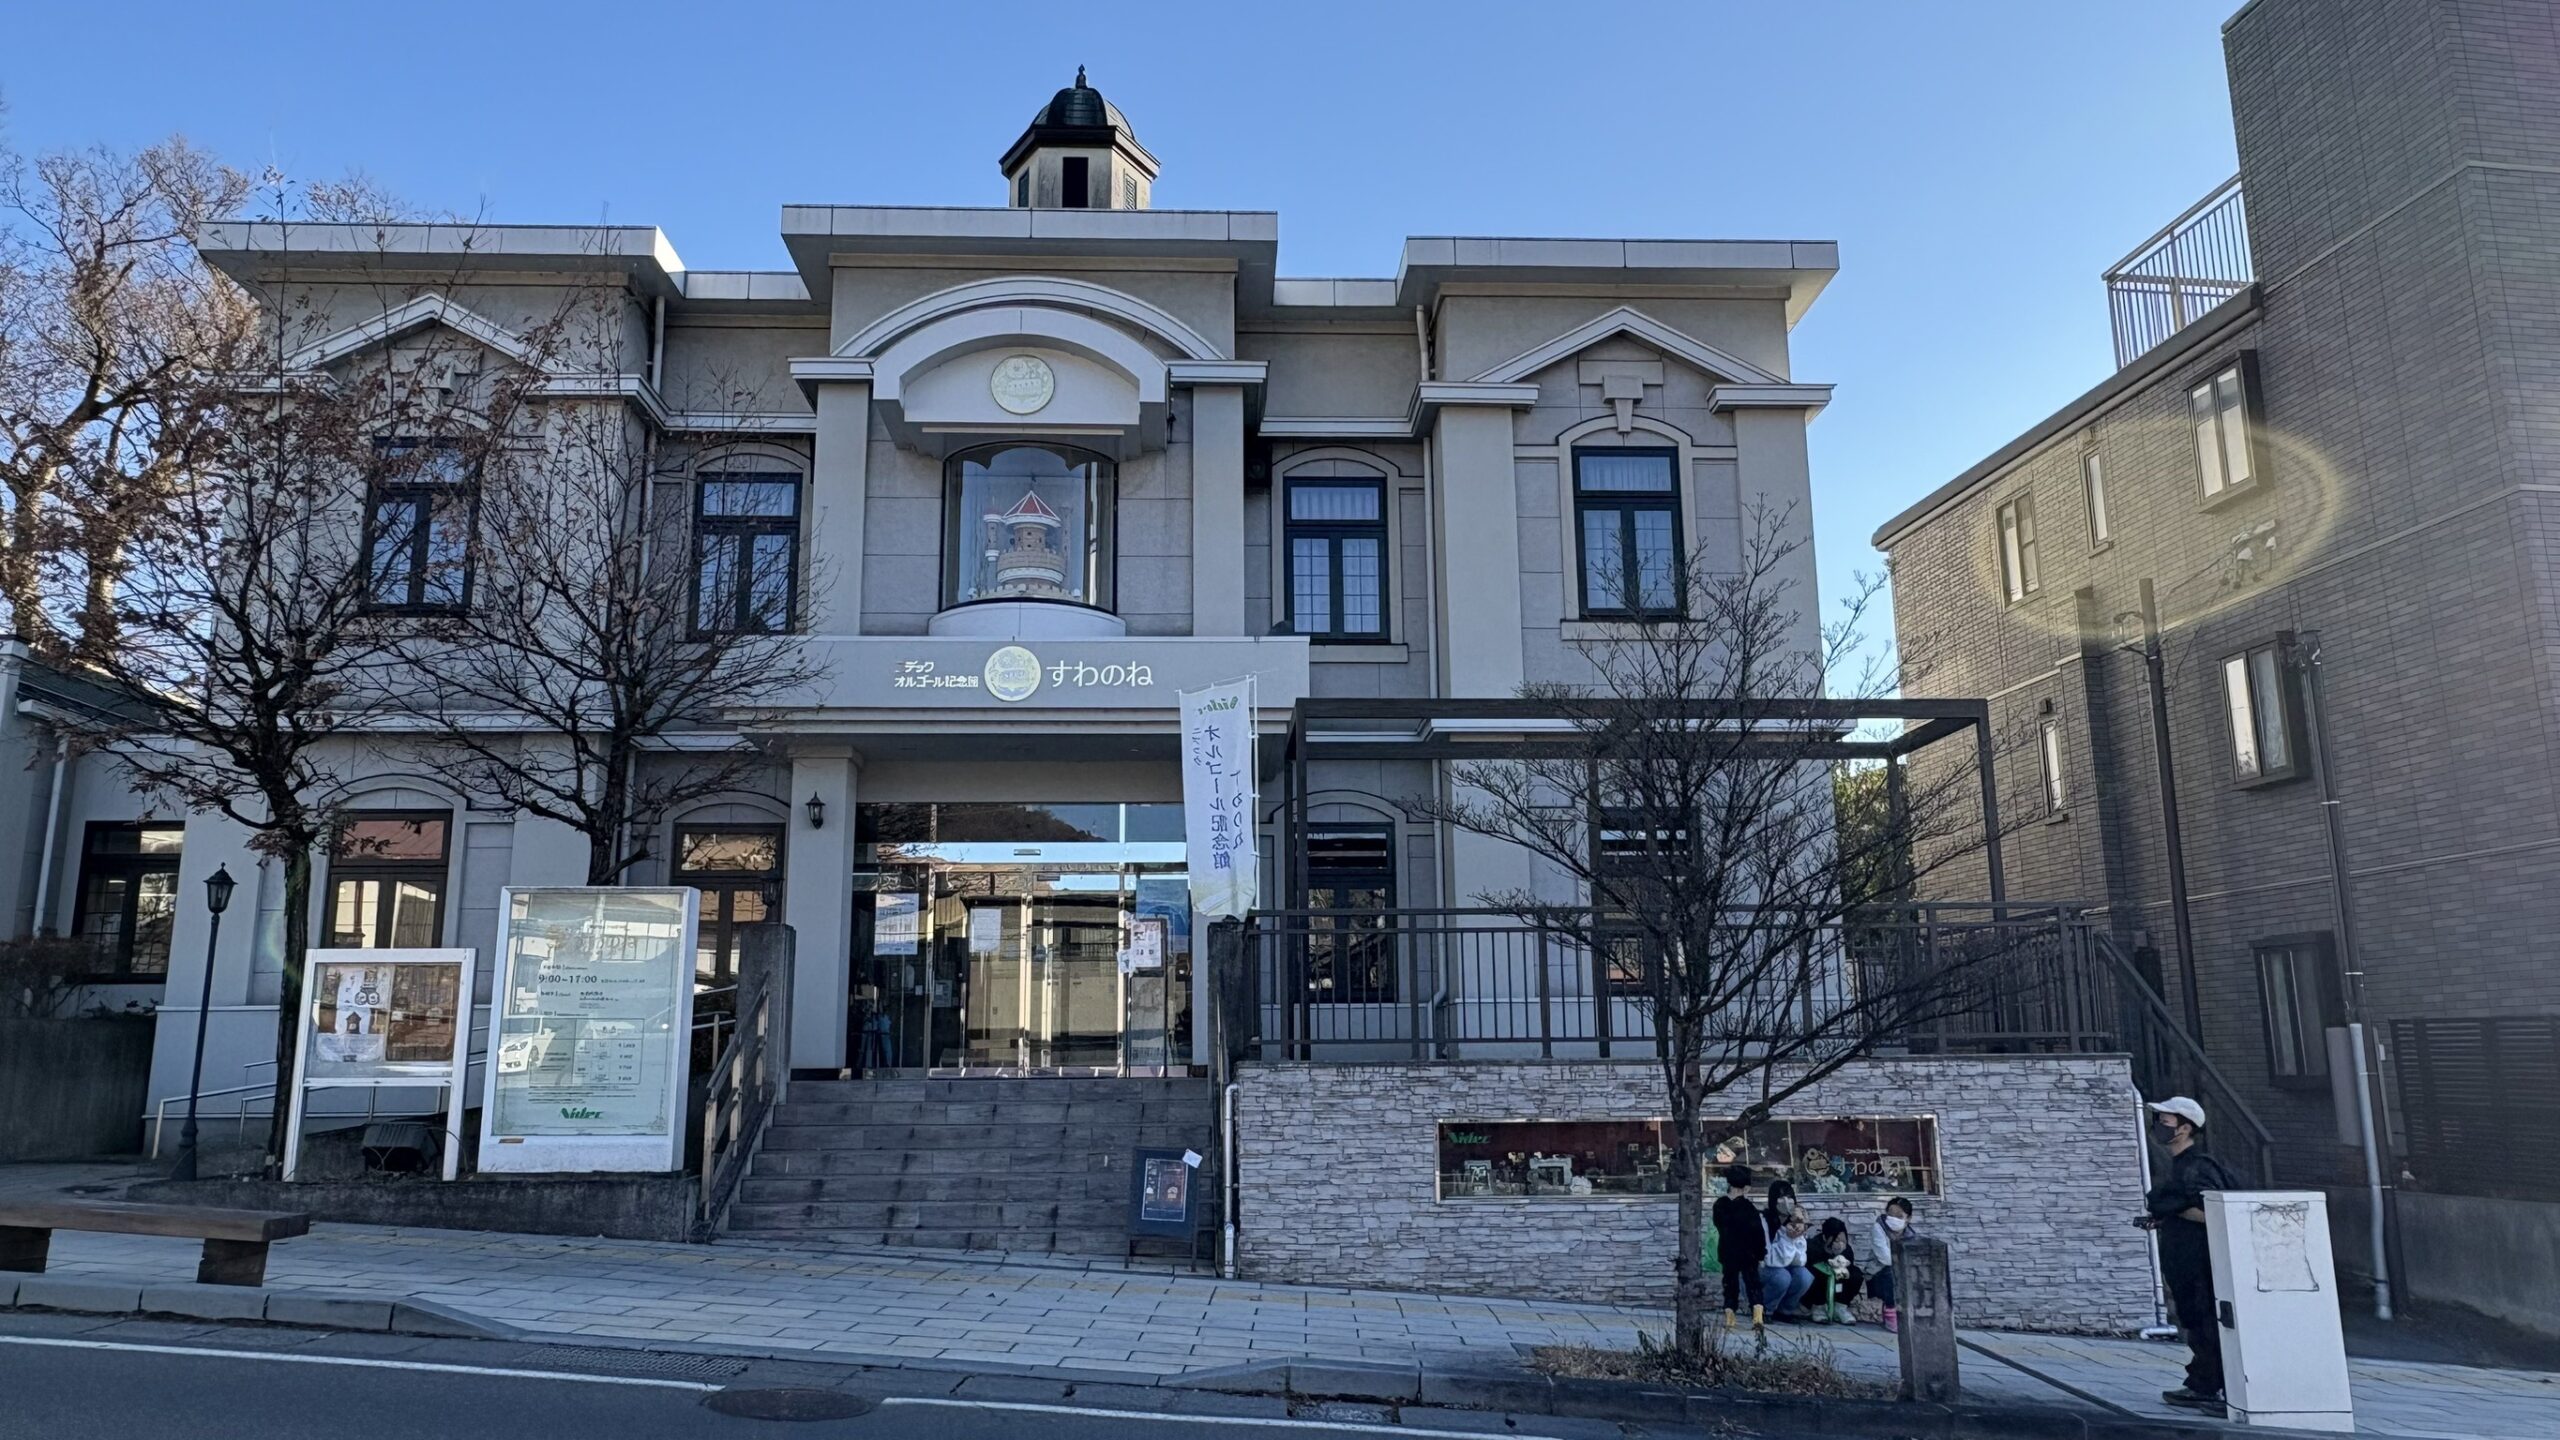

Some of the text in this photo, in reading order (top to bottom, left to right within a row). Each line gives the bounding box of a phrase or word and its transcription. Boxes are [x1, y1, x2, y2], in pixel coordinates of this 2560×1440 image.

[894, 674, 979, 688] オルゴール記念館
[1047, 660, 1154, 687] すわのね
